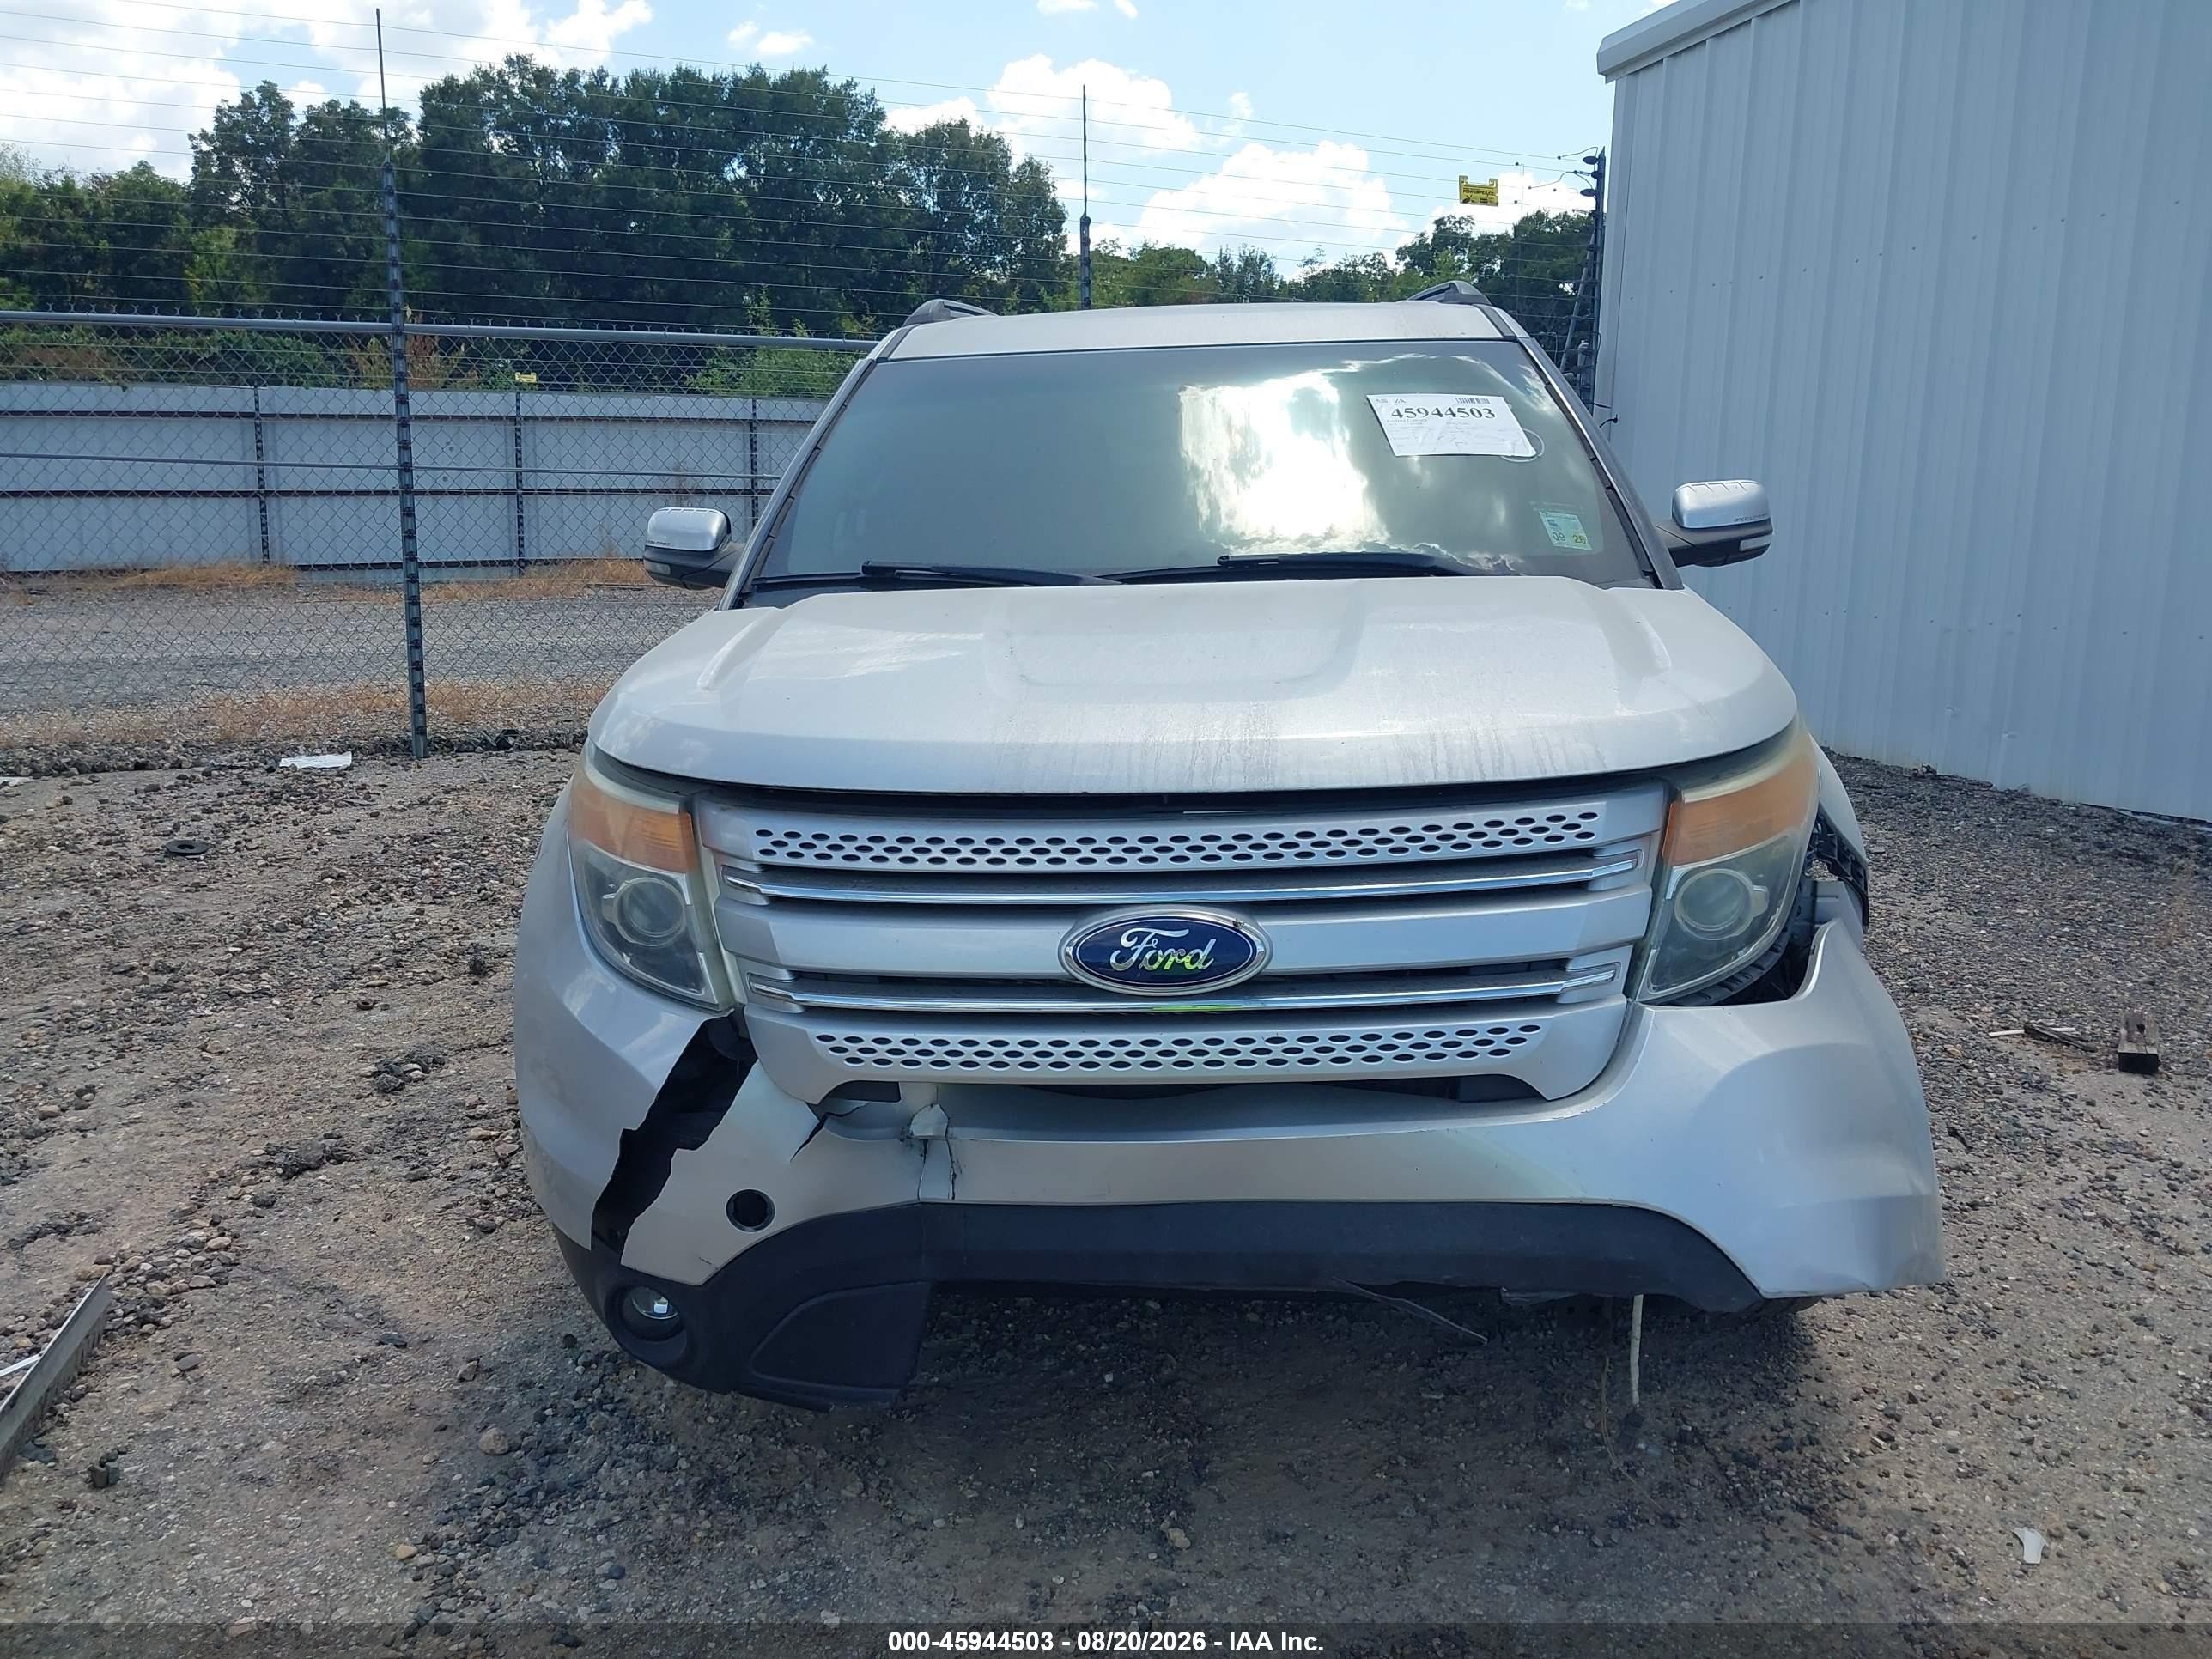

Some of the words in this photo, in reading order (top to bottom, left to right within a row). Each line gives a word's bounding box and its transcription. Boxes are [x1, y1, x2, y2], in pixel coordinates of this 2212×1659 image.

[1391, 407, 1497, 419] 45944503
[1552, 532, 1565, 542] 09
[1109, 927, 1217, 972] Ford
